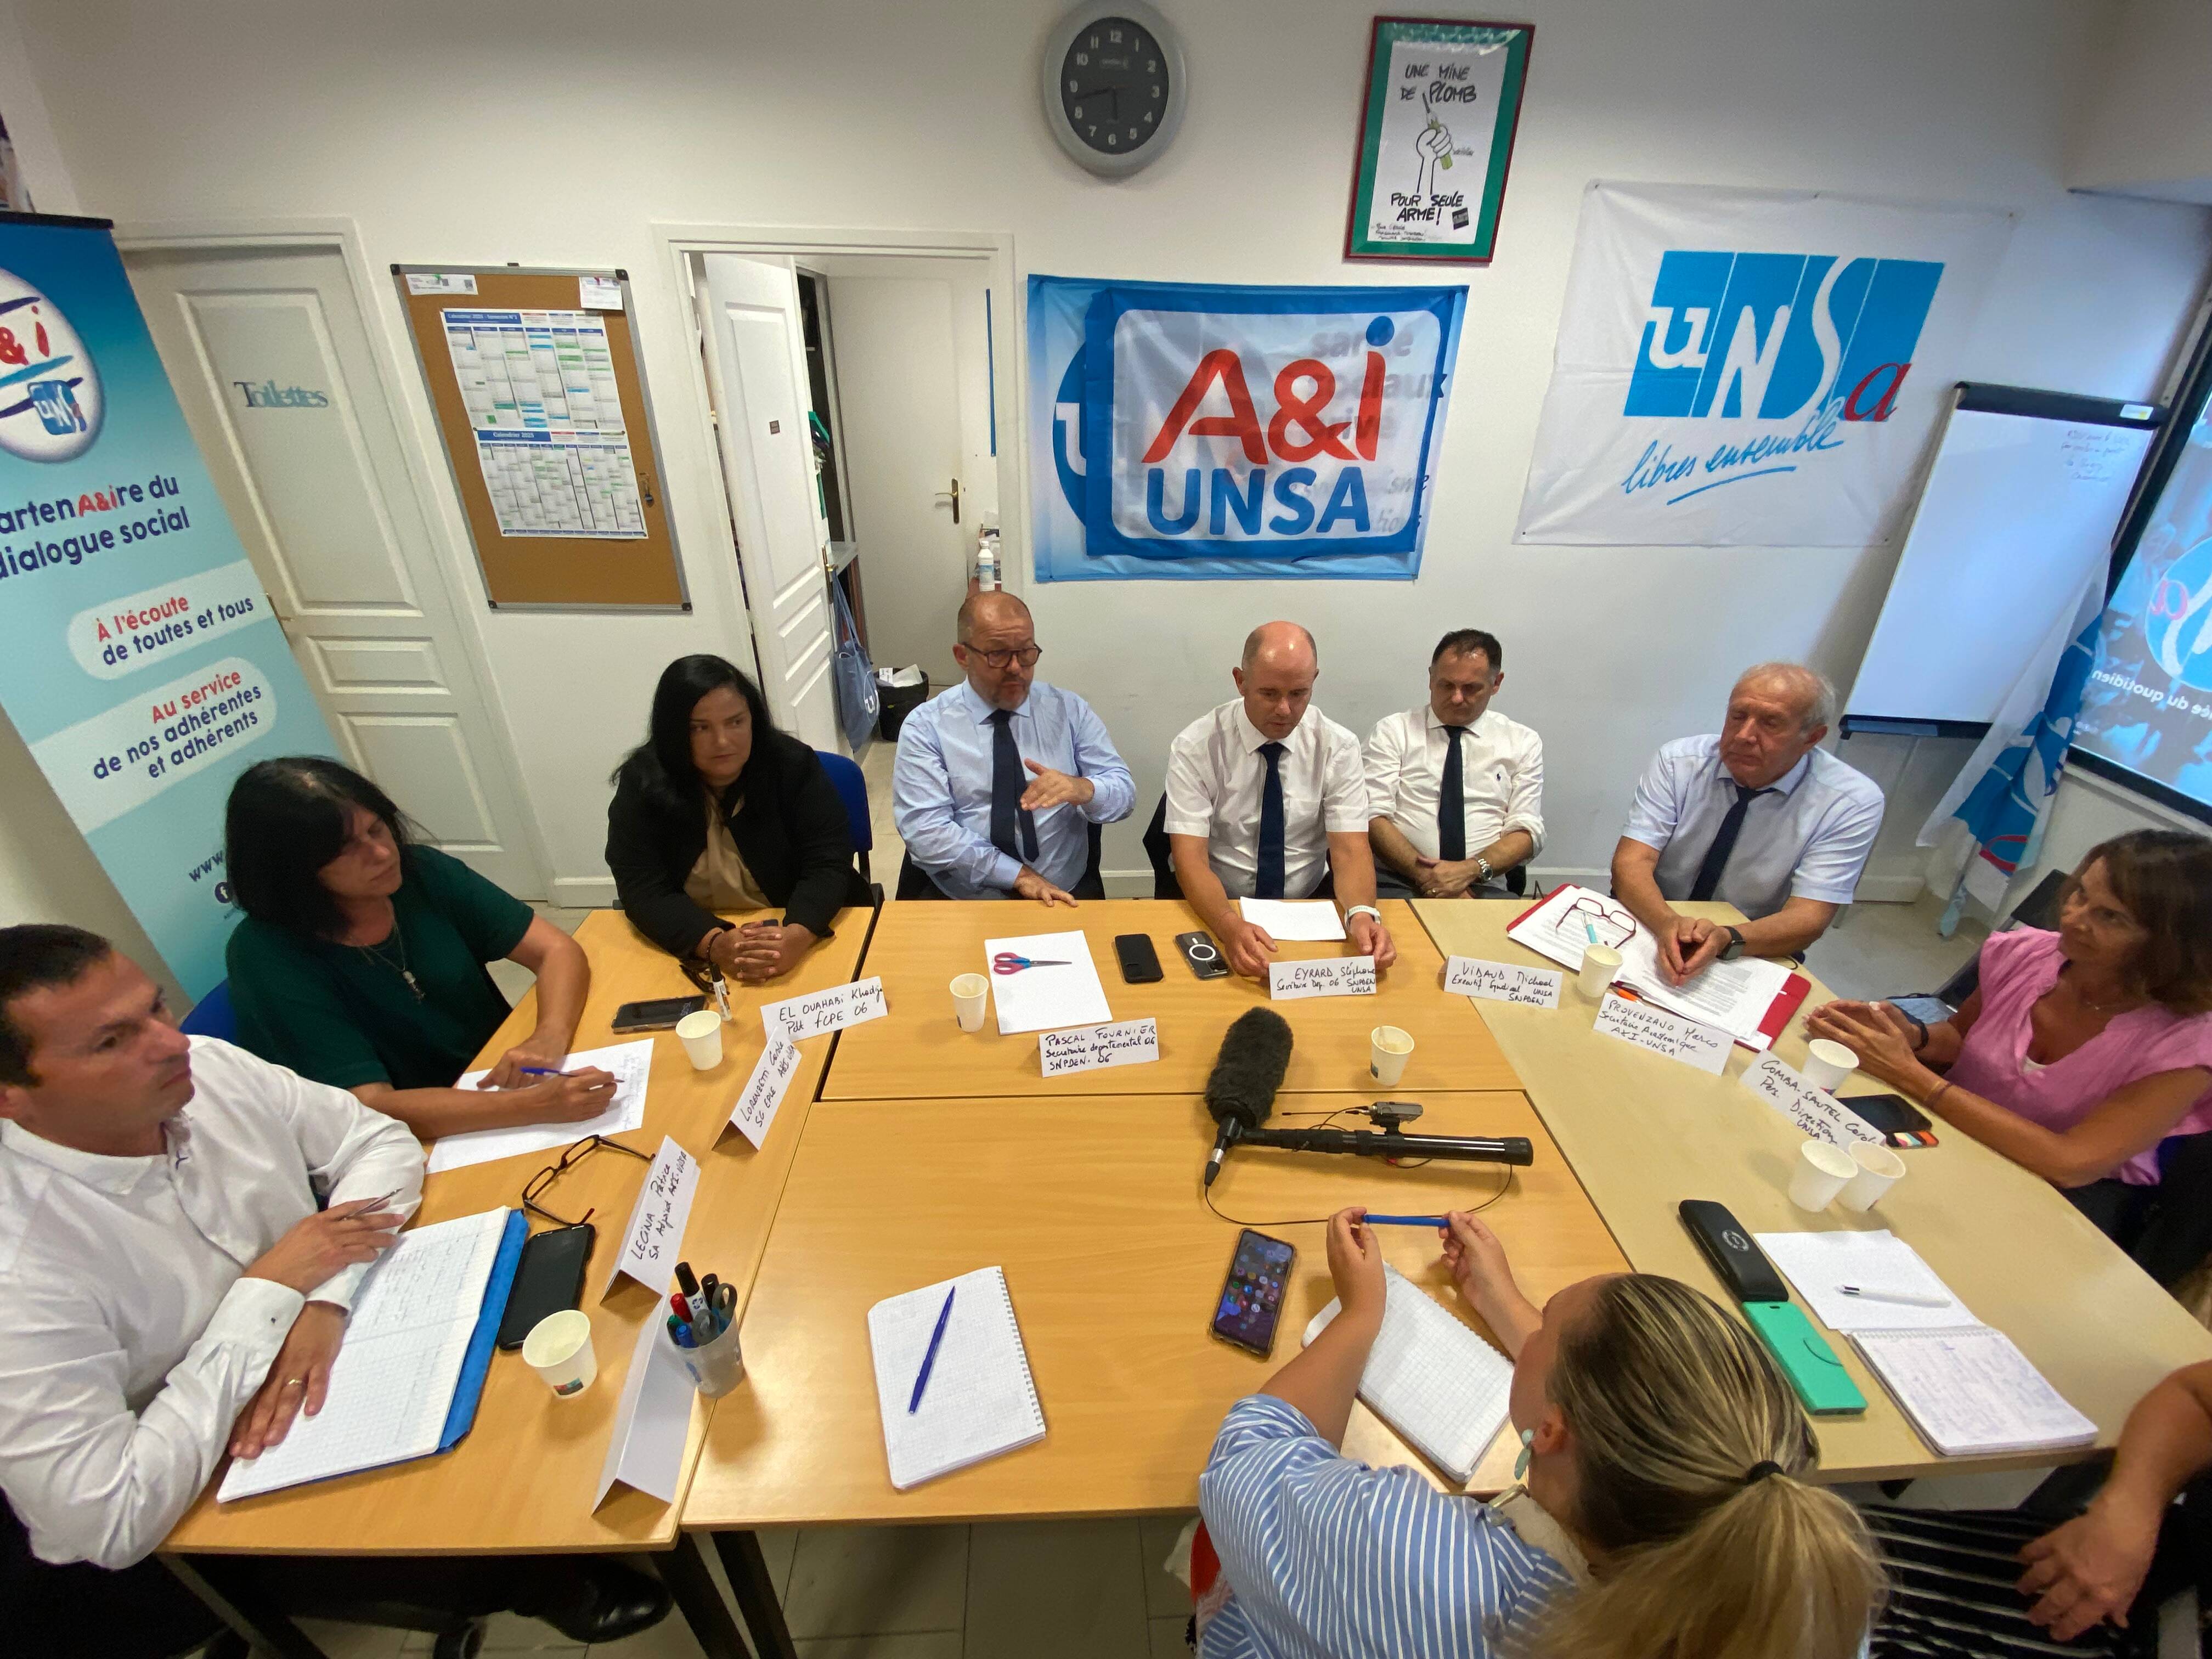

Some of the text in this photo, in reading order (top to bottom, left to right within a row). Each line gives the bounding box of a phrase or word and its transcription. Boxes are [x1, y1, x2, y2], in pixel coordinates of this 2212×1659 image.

[1110, 30, 1122, 43] 12
[1076, 52, 1088, 66] 10
[1147, 60, 1156, 72] 2
[1405, 63, 1430, 79] UNE
[1401, 81, 1477, 104] DE PLOMB
[1144, 111, 1153, 123] 4
[1088, 125, 1097, 137] 7
[1108, 133, 1116, 145] 6
[1391, 191, 1464, 207] POUR SEULE
[233, 379, 328, 408] Toilettes
[1621, 396, 1844, 494] libres ensemble
[0, 475, 180, 534] artenA&ire du
[1147, 466, 1370, 536] UNSA
[120, 506, 190, 544] social
[96, 596, 190, 642] À l'écoute
[103, 597, 253, 665] de toutes et tous
[152, 672, 241, 724] Au service
[93, 686, 262, 779] de nos adhérentes
[148, 710, 258, 778] et adhérents
[1295, 962, 1375, 981] EYRARD Stéphane
[1329, 978, 1339, 986] 06
[1509, 992, 1544, 1005] SNPDEN
[1533, 988, 1553, 997] UNSA
[780, 1007, 795, 1022] EL
[854, 1002, 868, 1015] 06
[1609, 1000, 1718, 1048] PROVENZANO Marco
[1046, 1034, 1085, 1047] PASCAL
[1144, 1036, 1156, 1045] 06
[1098, 1052, 1113, 1063] 06
[764, 1086, 776, 1108] EPLE
[1797, 1119, 1821, 1139] UNSA
